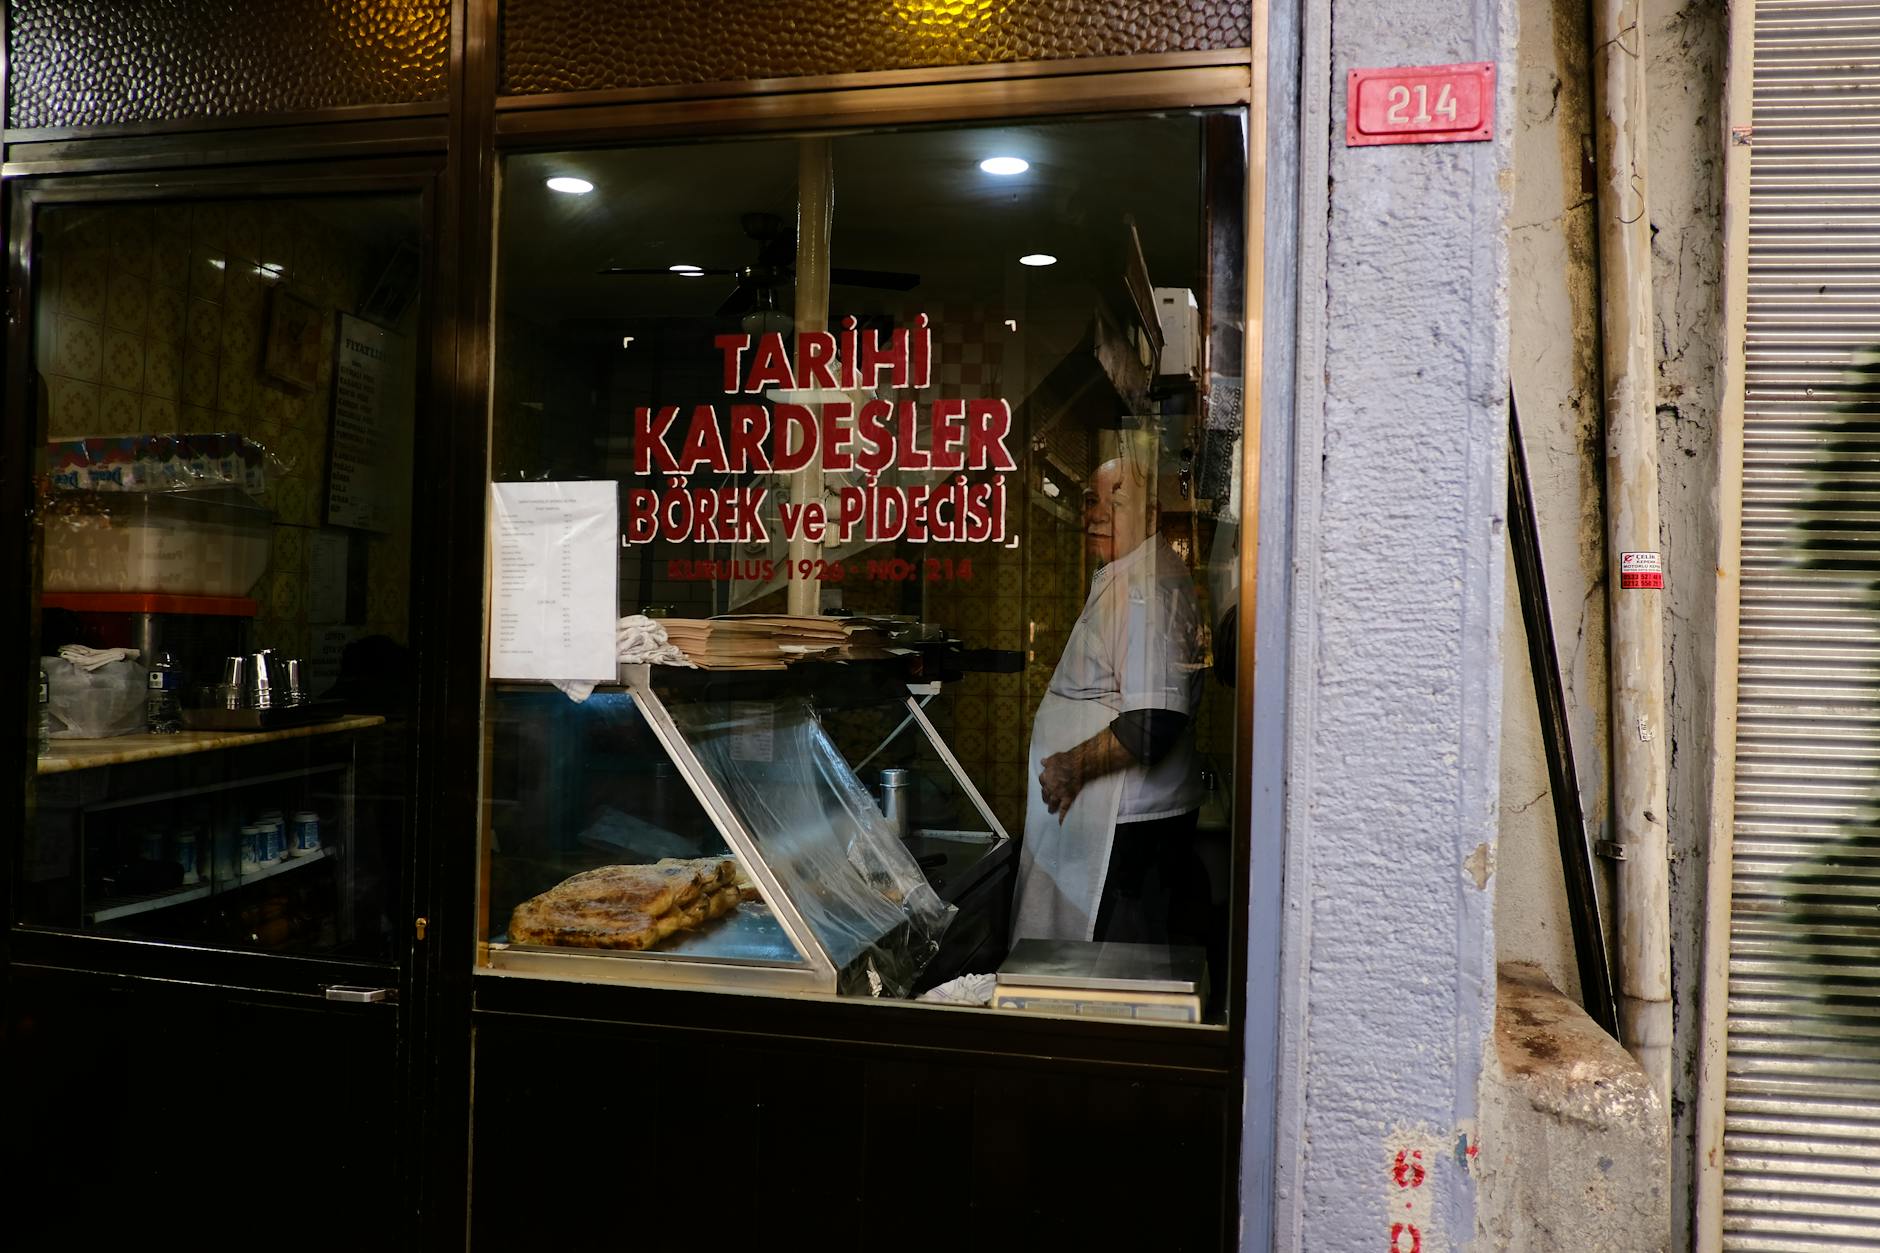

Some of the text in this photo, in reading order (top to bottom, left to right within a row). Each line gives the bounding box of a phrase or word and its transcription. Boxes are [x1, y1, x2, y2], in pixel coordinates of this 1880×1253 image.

[1387, 83, 1457, 125] 214
[714, 313, 932, 394] TARİHİ
[633, 399, 1018, 477] KARDEŞLER
[627, 474, 1008, 543] BÖREK ve PİDECİSİ
[667, 559, 973, 584] KURULUŞ 1926 NO: 214
